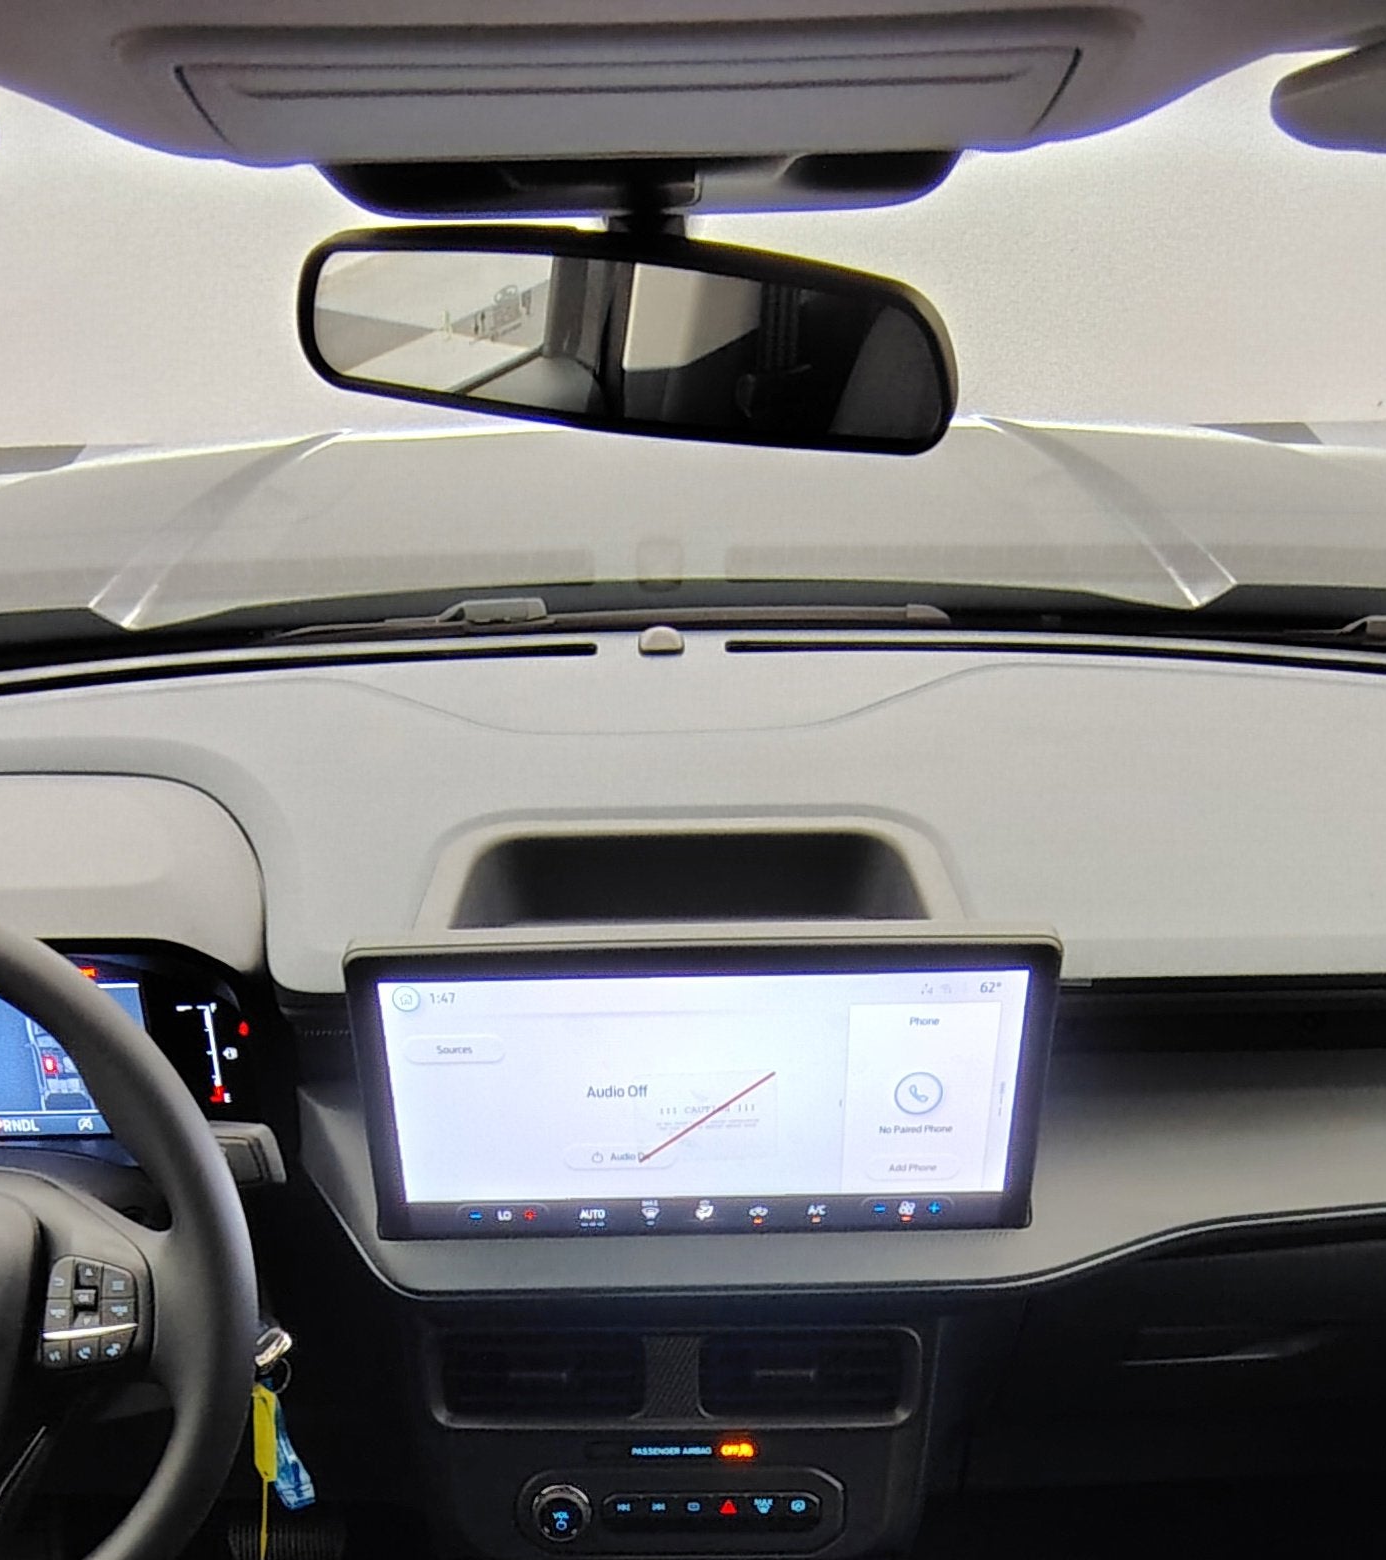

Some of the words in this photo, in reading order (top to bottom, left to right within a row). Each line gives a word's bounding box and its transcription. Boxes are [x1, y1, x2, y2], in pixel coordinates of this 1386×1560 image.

[430, 992, 455, 1004] 1:47
[910, 1016, 940, 1026] Phone
[437, 1044, 472, 1055] Sources
[586, 1085, 625, 1098] Audio
[628, 1084, 648, 1097] Off
[879, 1125, 892, 1134] No
[894, 1125, 922, 1134] Paired
[924, 1124, 953, 1133] Phone
[610, 1152, 636, 1162] Audio
[889, 1163, 907, 1172] Add
[909, 1162, 937, 1171] Phone
[497, 1210, 512, 1221] LO
[579, 1208, 605, 1219] AUTO
[631, 1446, 680, 1455] PASSENGER
[682, 1446, 712, 1455] AIRBAG
